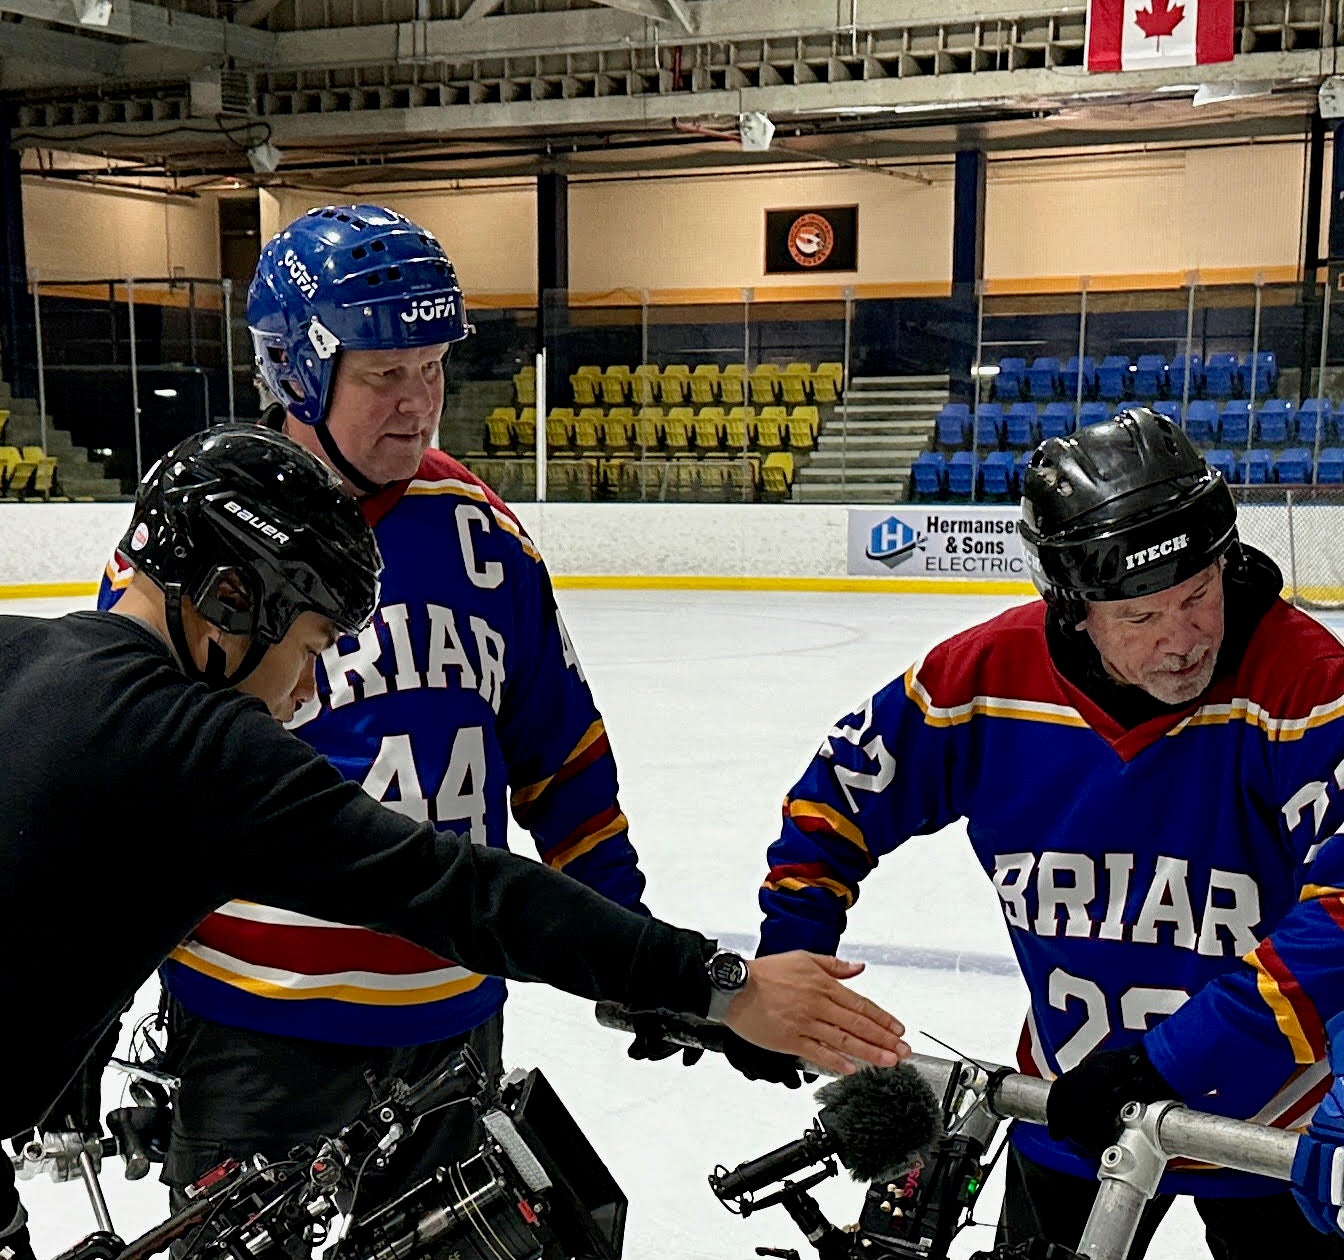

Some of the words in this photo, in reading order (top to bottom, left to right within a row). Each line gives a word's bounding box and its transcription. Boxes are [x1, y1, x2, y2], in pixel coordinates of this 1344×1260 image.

[400, 294, 456, 324] JOFA
[454, 502, 505, 590] C
[926, 556, 1024, 573] ELECTRIC
[946, 538, 958, 555] &
[962, 539, 1005, 555] Sons
[1125, 533, 1189, 570] ITECH
[360, 725, 487, 847] 44
[992, 851, 1261, 958] BRIAR
